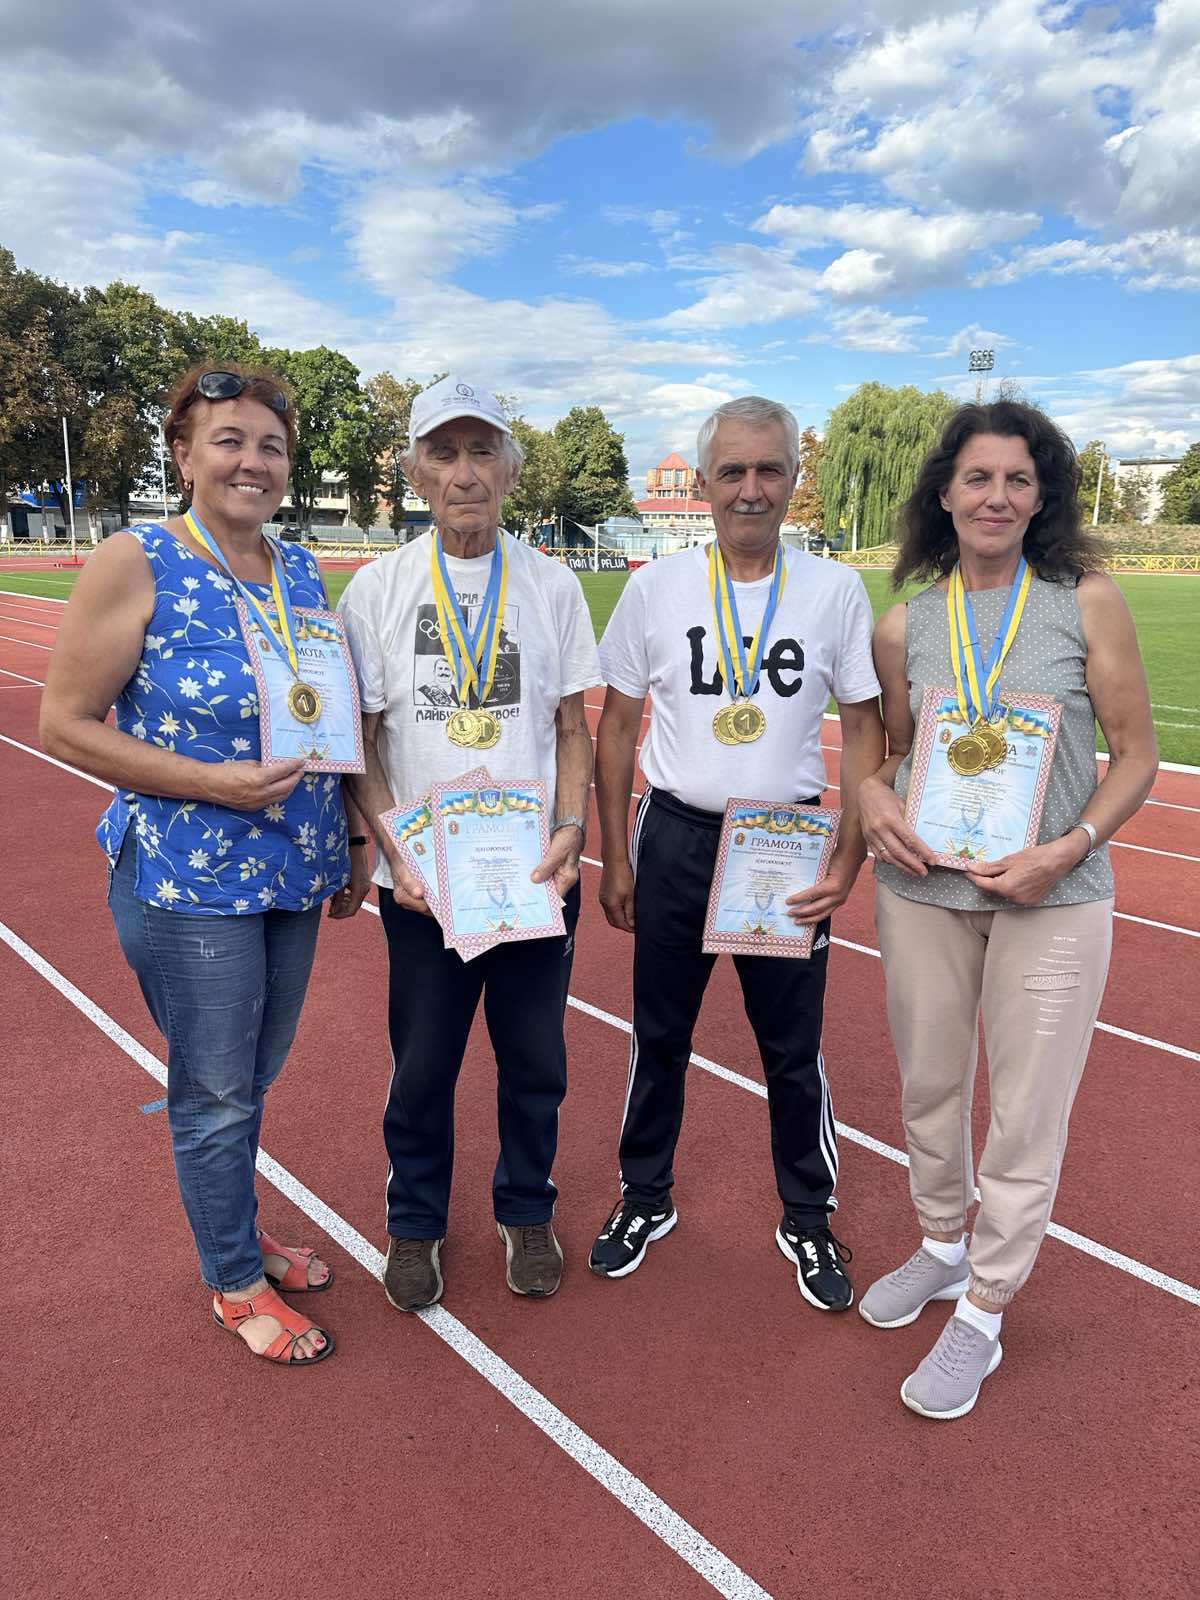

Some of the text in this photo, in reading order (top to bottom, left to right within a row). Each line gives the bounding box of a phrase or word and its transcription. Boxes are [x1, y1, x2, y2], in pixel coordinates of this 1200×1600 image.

[569, 558, 587, 569] ПФЛ
[456, 591, 478, 605] ОРІЯ
[299, 647, 326, 660] МОТА
[686, 625, 805, 698] Le
[416, 707, 451, 723] МАЙБУ
[740, 713, 751, 731] 1
[751, 837, 802, 851] ГРАМОТА
